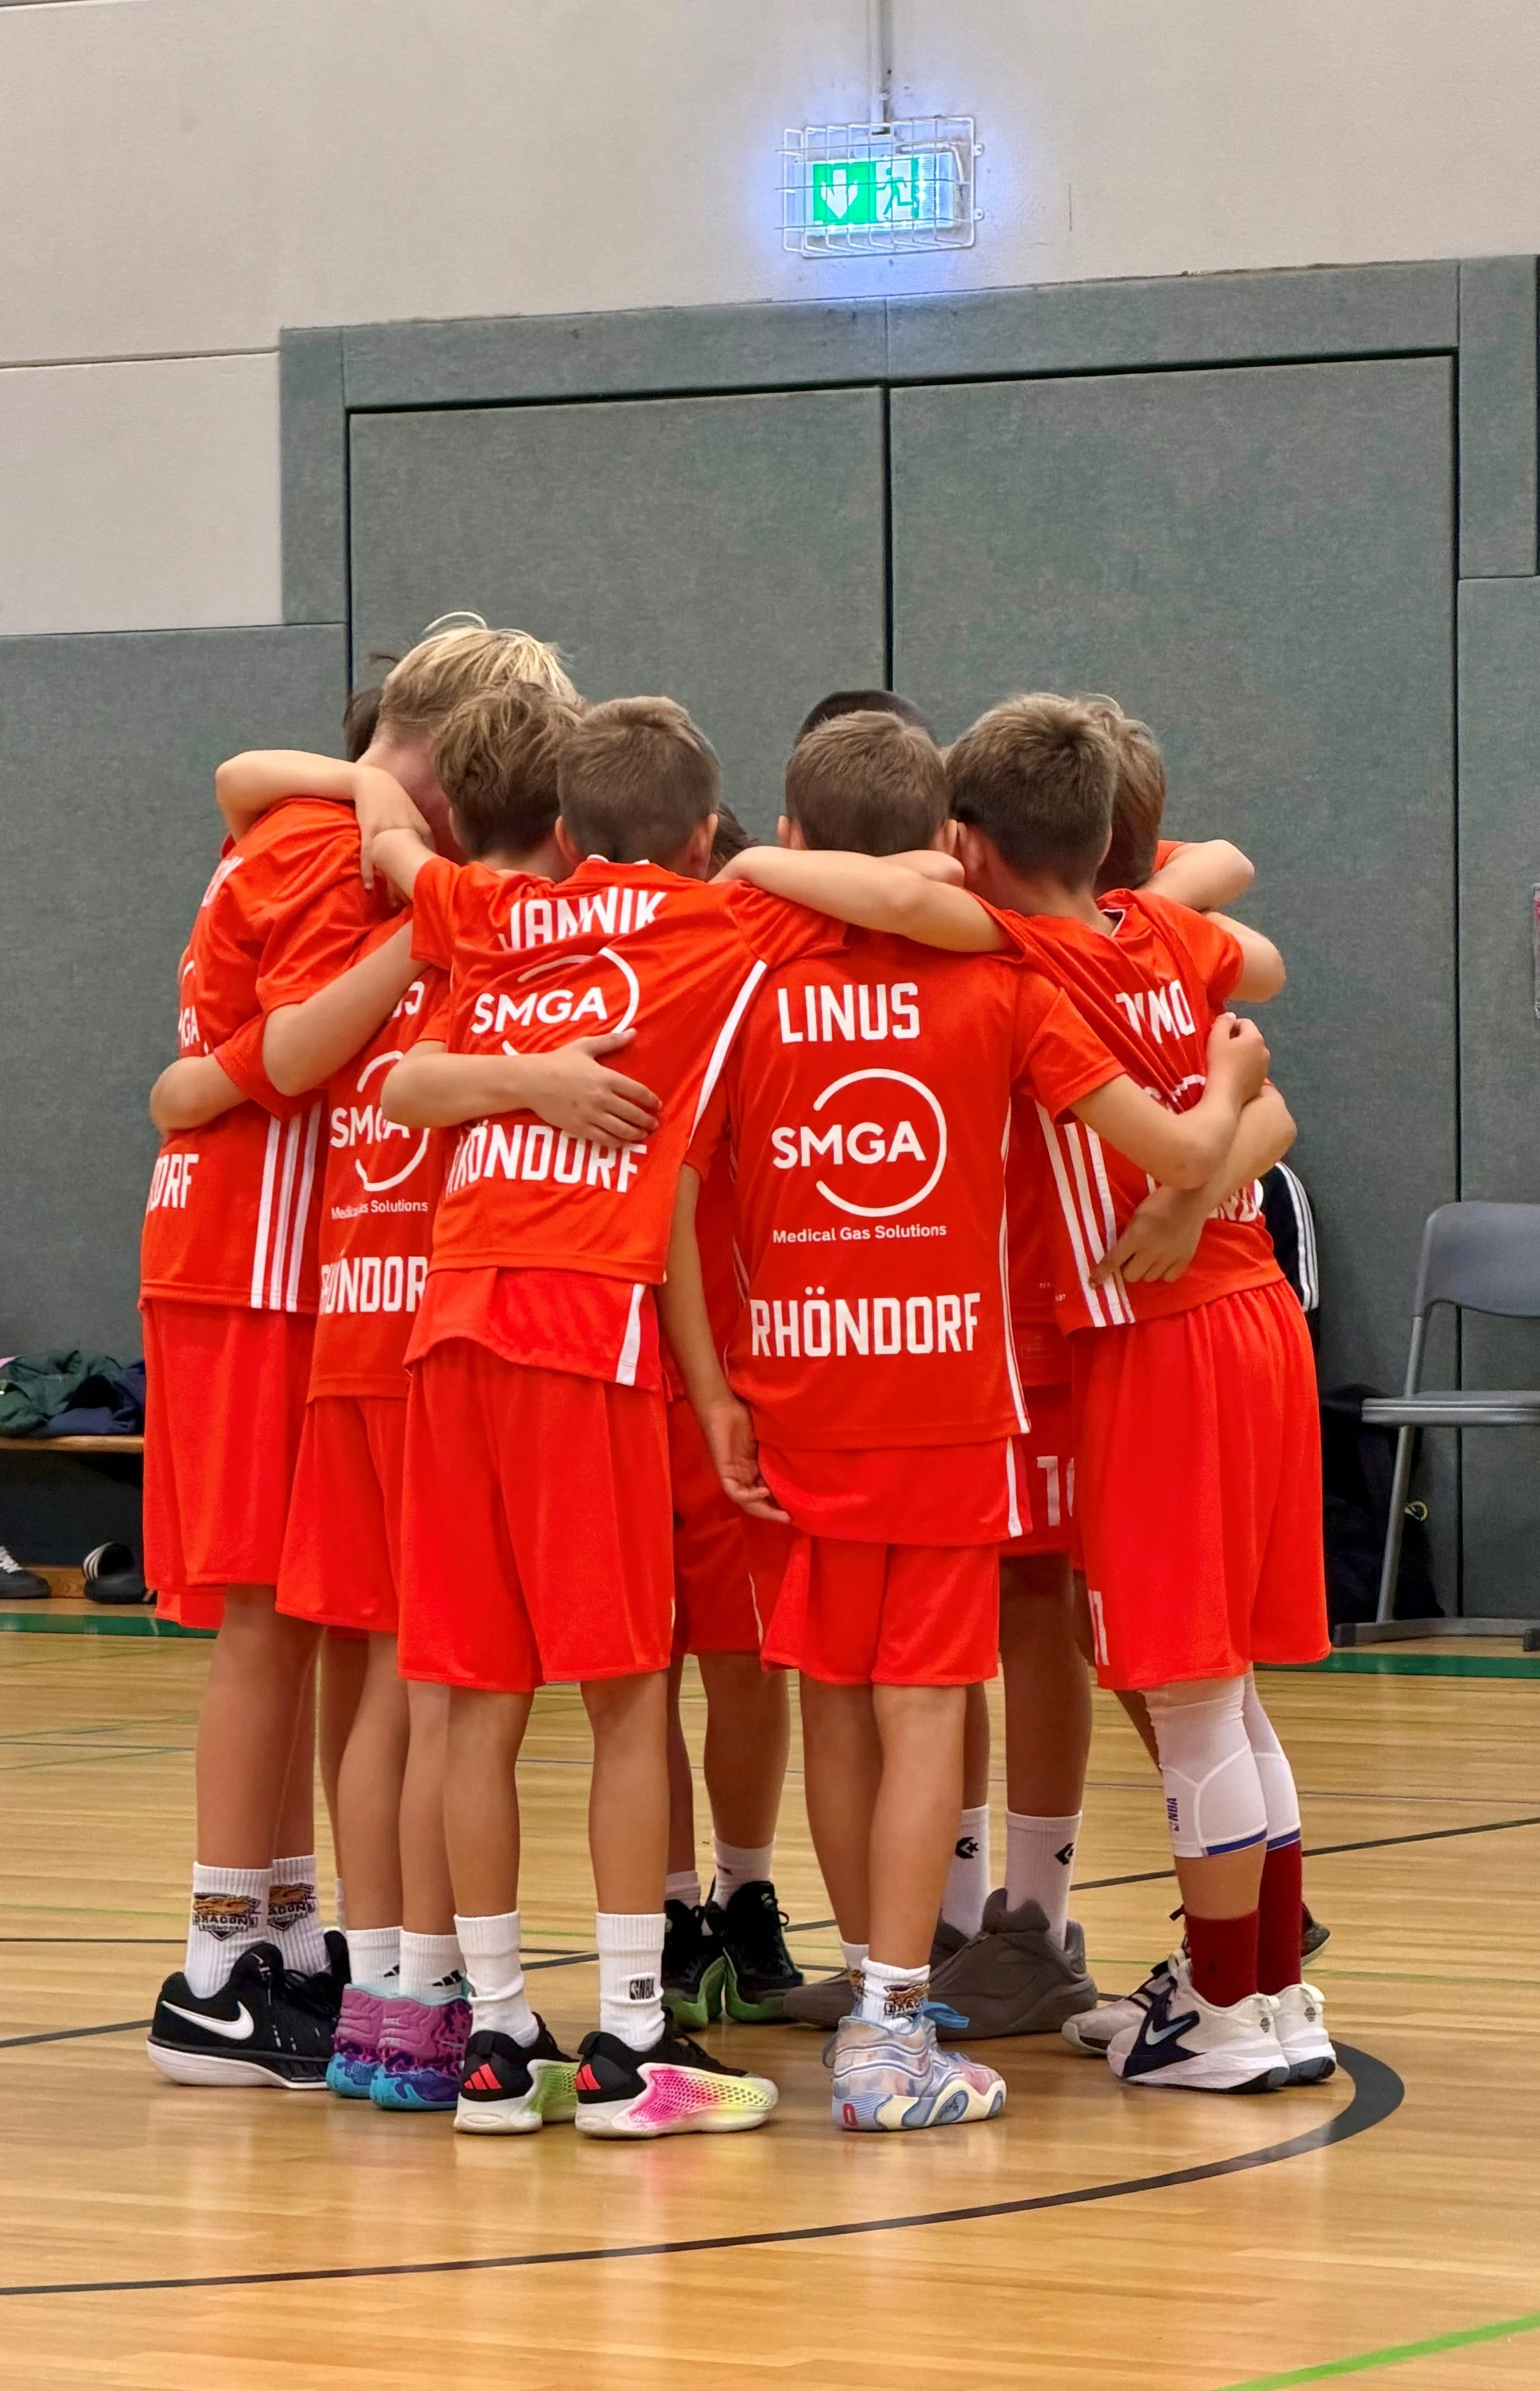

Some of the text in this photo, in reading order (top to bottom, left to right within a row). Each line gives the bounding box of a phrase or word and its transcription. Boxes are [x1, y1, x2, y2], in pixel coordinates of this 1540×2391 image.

[178, 1005, 201, 1049] GA
[471, 987, 607, 1034] SMGA
[777, 982, 920, 1044] LINUS
[771, 1121, 926, 1169] SMGA
[371, 1199, 428, 1213] Solutions
[773, 1224, 947, 1243] Medical Gas Solutions
[750, 1286, 981, 1357] RHÖNDORF
[639, 1978, 655, 2000] NBA
